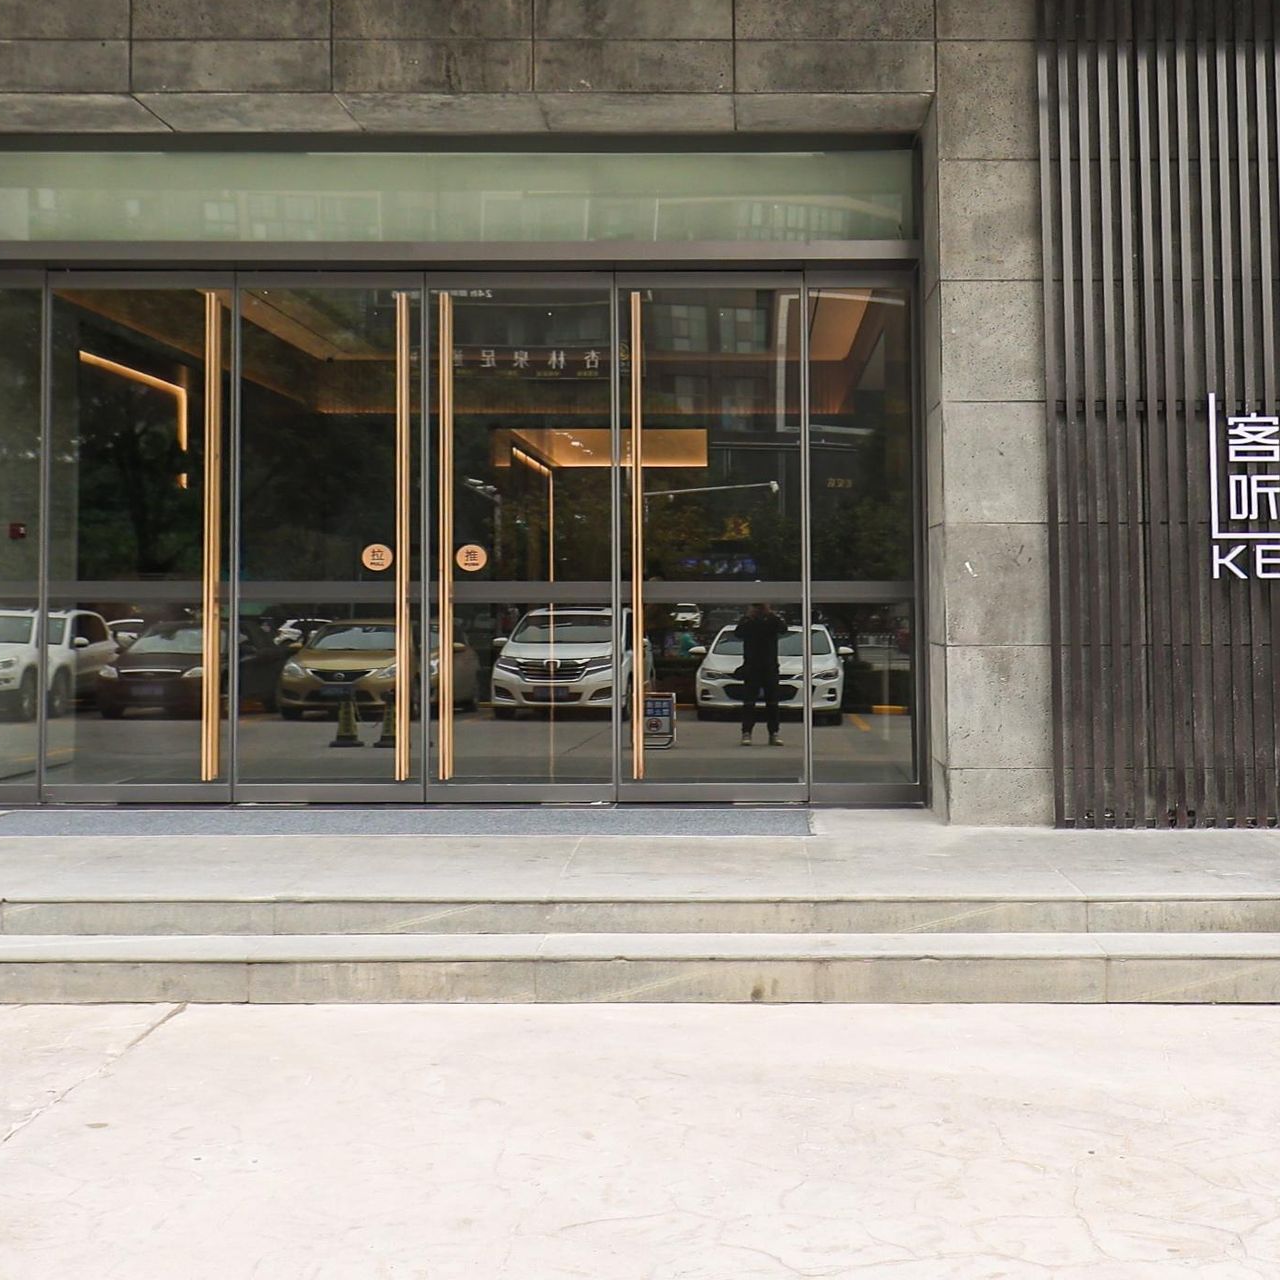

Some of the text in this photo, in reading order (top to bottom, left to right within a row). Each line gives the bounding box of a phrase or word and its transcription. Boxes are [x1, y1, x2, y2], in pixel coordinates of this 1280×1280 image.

[1227, 411, 1280, 520] 客听
[371, 548, 385, 560] 拉
[464, 549, 479, 562] 推
